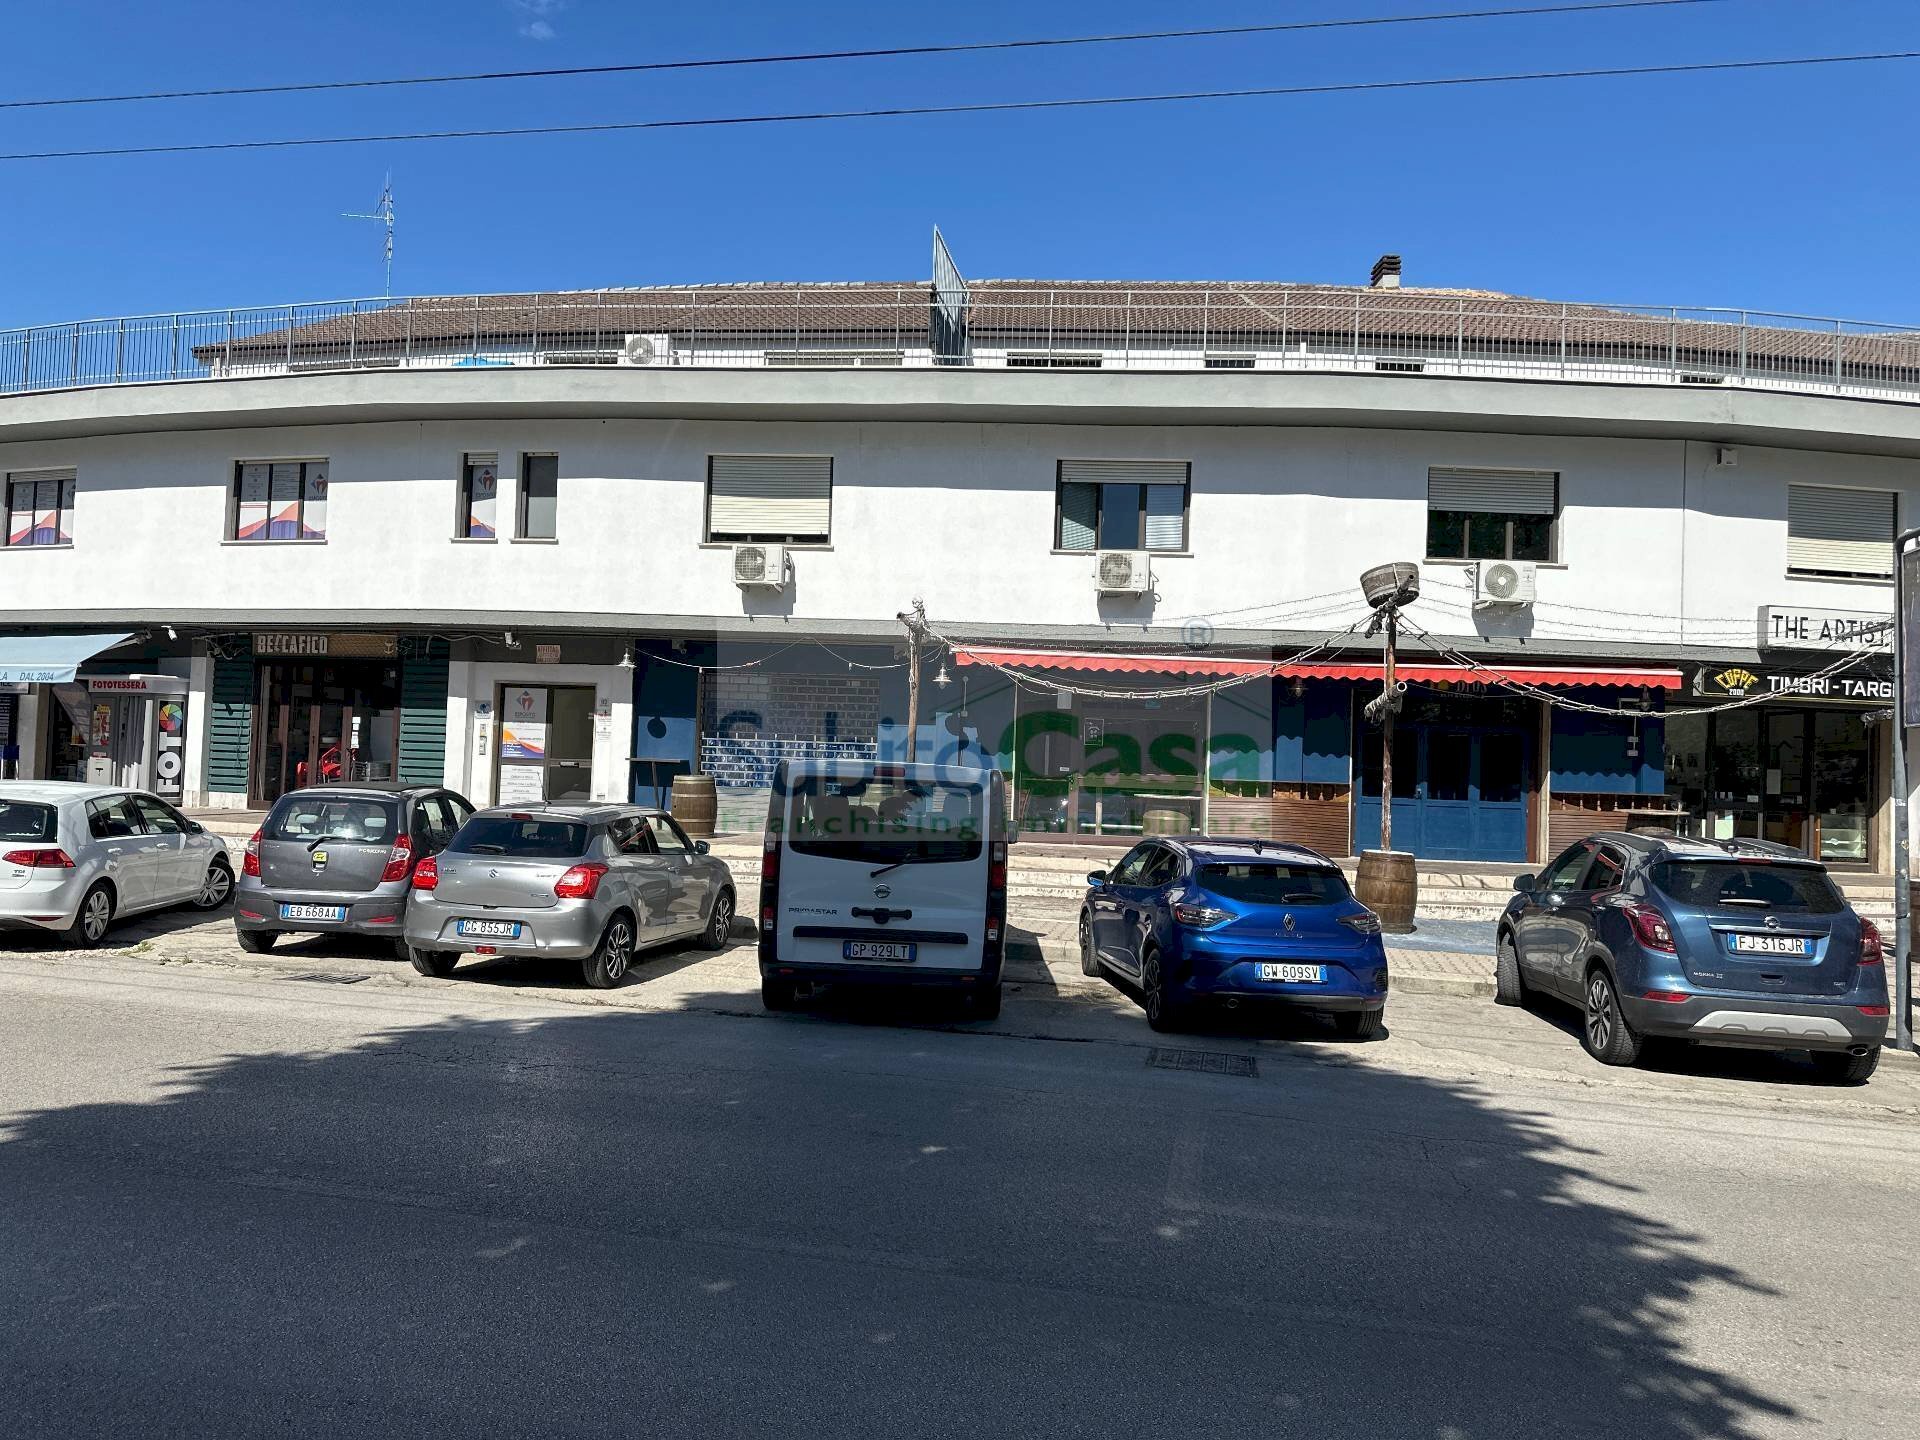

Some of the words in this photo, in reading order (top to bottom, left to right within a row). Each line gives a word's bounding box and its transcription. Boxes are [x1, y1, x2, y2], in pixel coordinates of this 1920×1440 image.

[1772, 614, 1809, 640] THE
[19, 672, 35, 681] DAL
[1714, 669, 1759, 689] COPPE
[92, 680, 147, 690] FOTOTESSERA
[1728, 688, 1745, 696] 2000
[289, 906, 303, 917] EB
[480, 921, 513, 935] 855JR
[852, 943, 866, 956] GP
[871, 944, 908, 958] 929LT
[1739, 935, 1756, 949] FJ
[1761, 936, 1804, 953] 316JR
[1263, 965, 1278, 978] GW
[1282, 966, 1318, 979] 609SV
